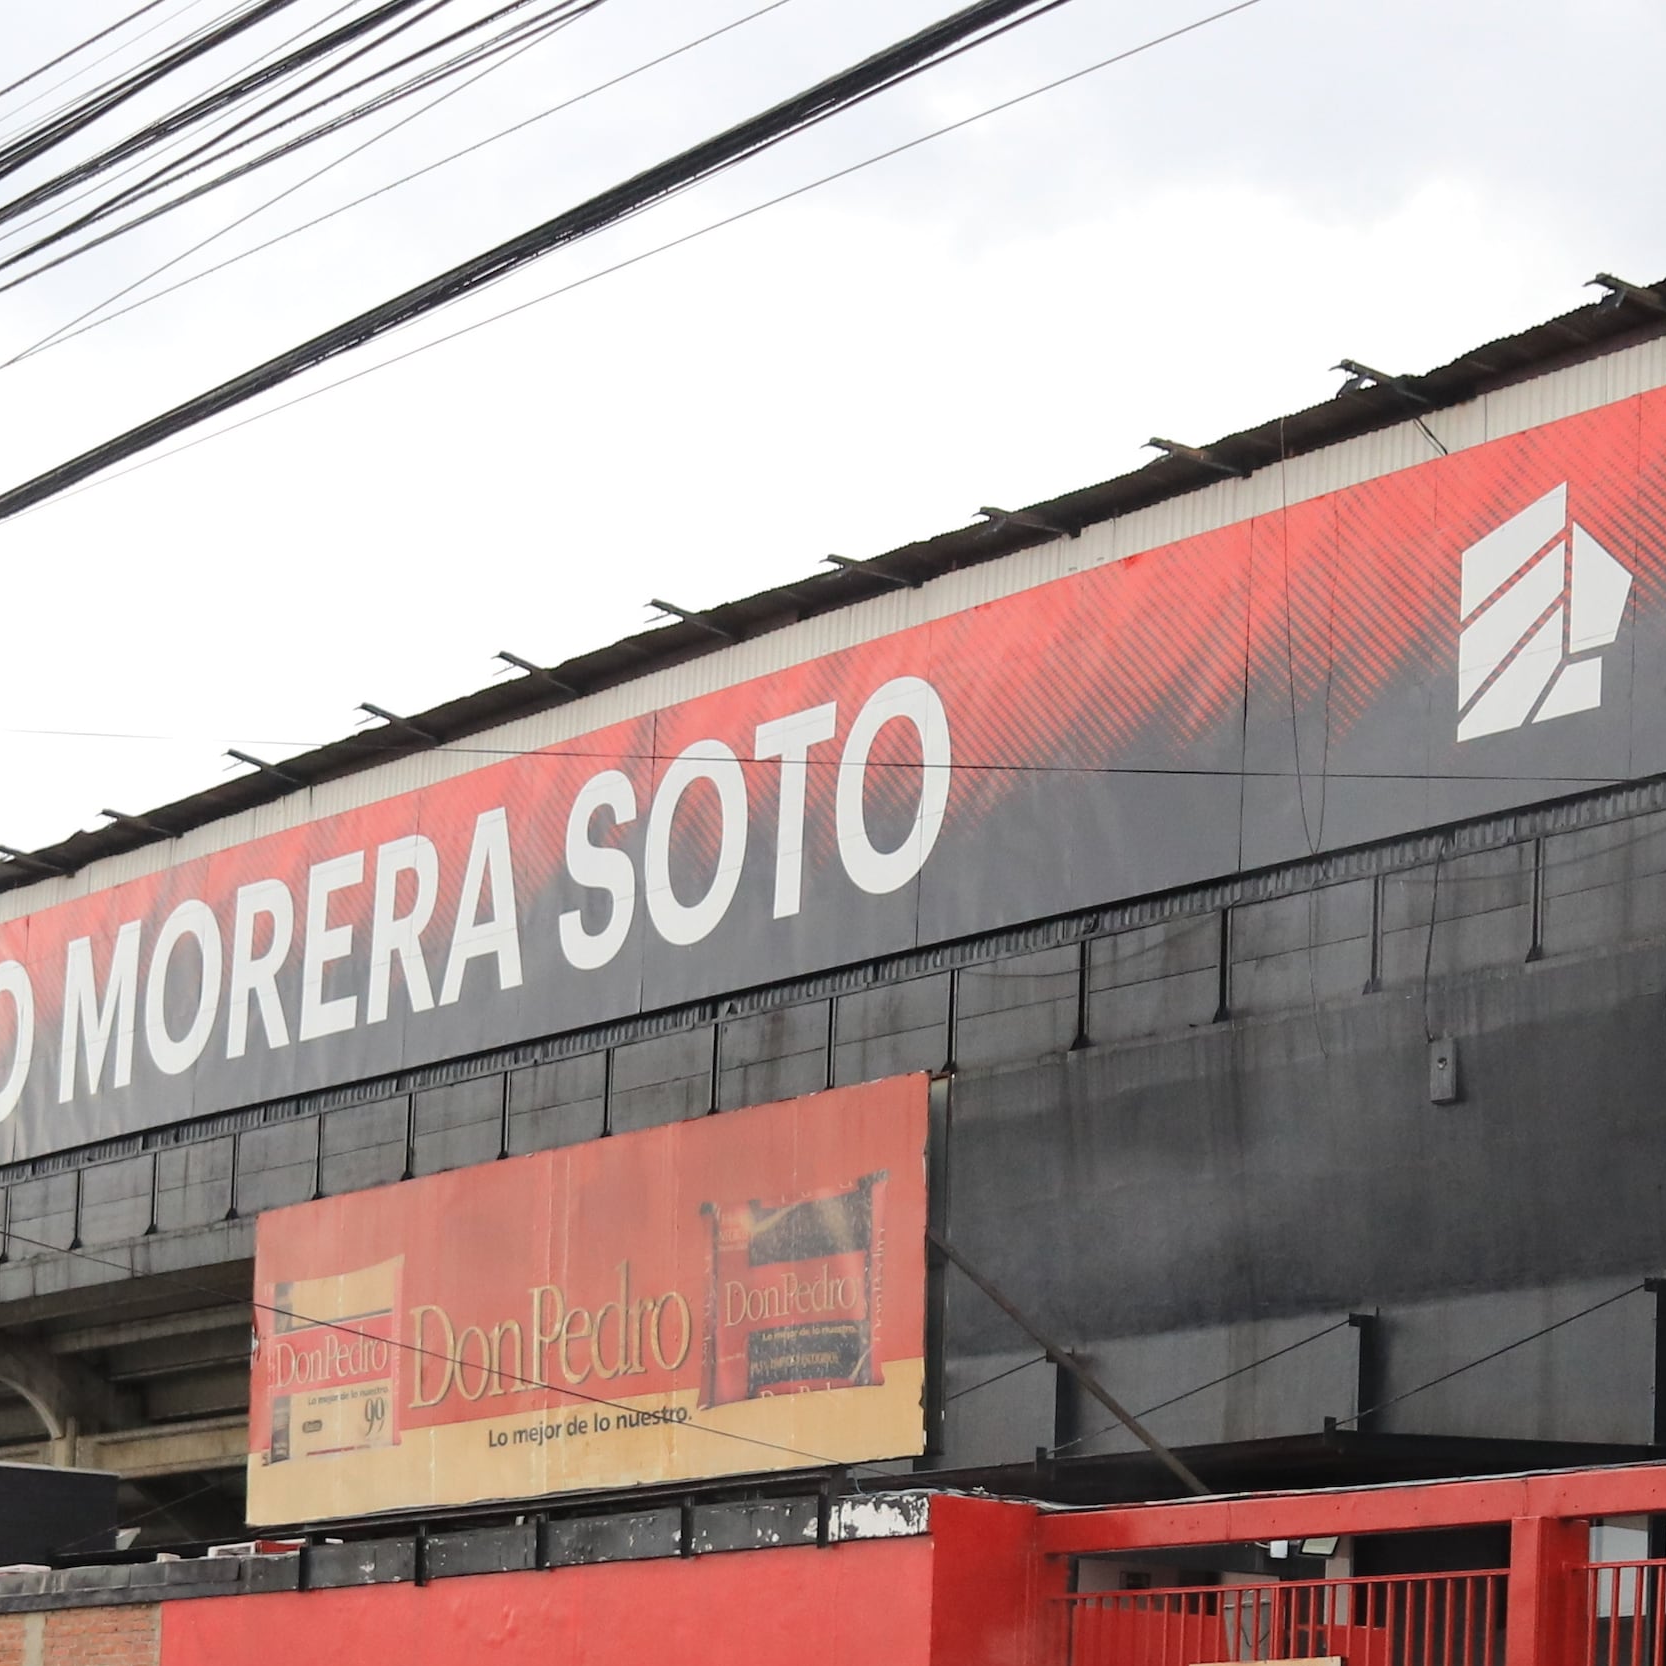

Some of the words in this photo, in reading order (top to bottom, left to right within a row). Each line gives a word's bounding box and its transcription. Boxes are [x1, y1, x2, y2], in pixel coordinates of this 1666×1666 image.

[58, 806, 523, 1104] MORERA
[558, 675, 951, 971] SOTO
[489, 1430, 508, 1447] Lo
[513, 1421, 562, 1446] mejor
[567, 1415, 588, 1436] de
[594, 1412, 611, 1432] lo
[616, 1405, 693, 1430] nuestro.
